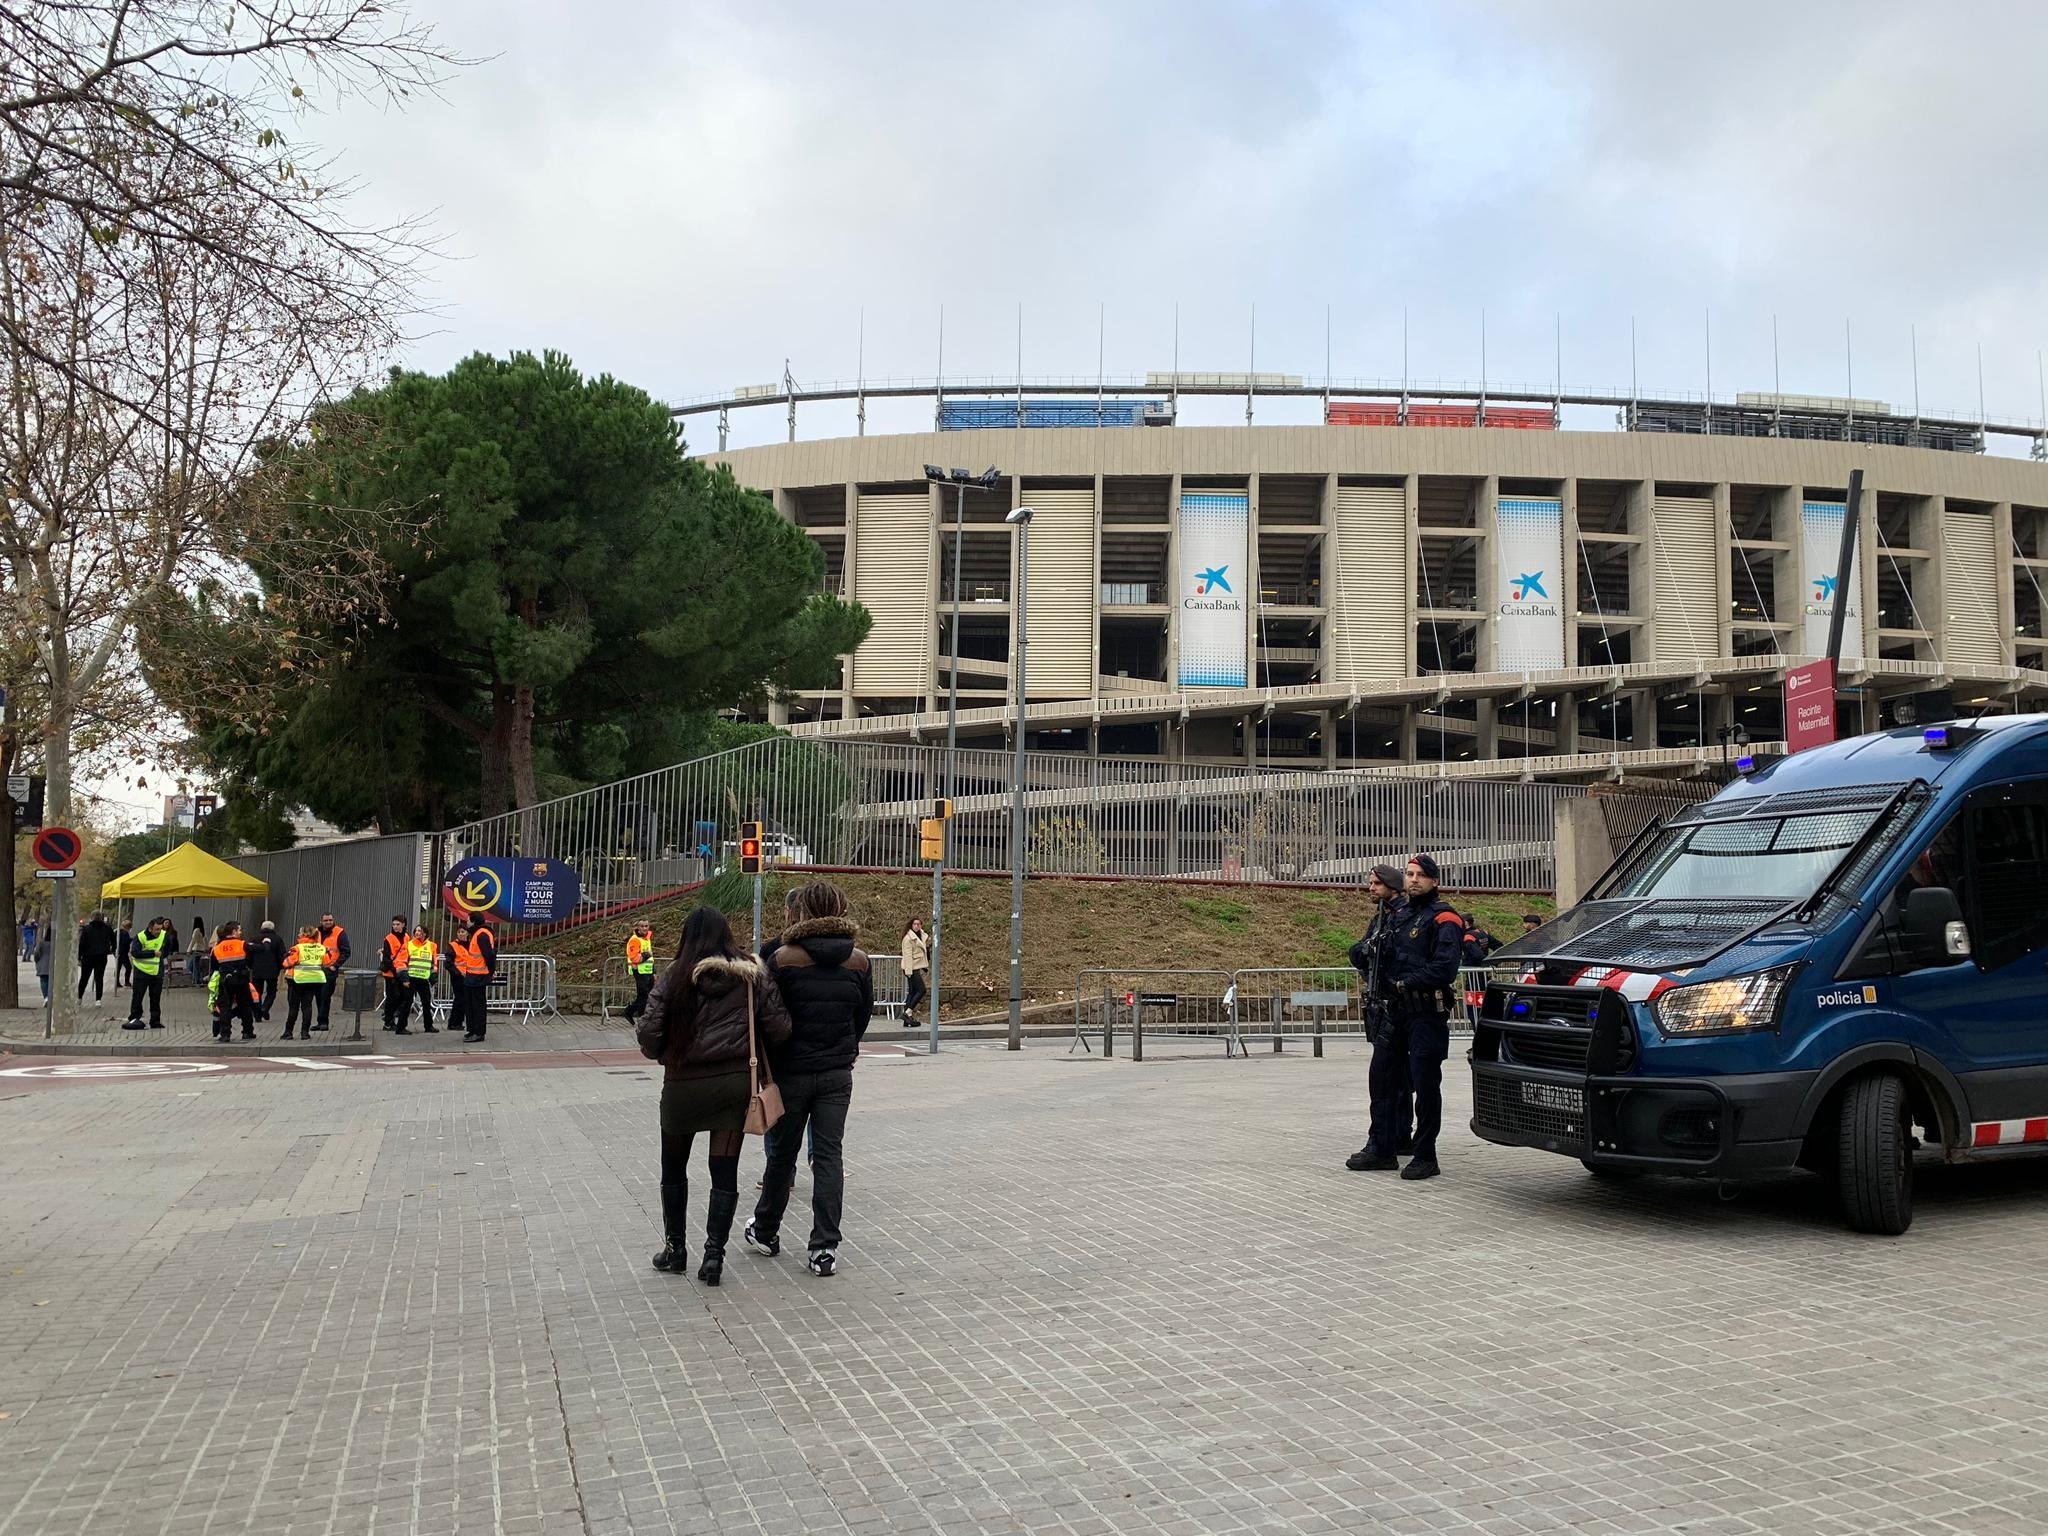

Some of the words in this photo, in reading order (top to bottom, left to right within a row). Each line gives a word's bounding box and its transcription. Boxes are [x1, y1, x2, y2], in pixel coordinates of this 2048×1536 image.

[1184, 598, 1241, 611] CaixaBank
[1501, 604, 1557, 617] CaixaBank
[1805, 604, 1857, 618] Caixank
[1798, 704, 1822, 719] Recinte
[1798, 715, 1831, 732] Maternitat
[198, 805, 213, 816] 19
[525, 890, 554, 899] TOUR
[1817, 990, 1862, 1008] policia
